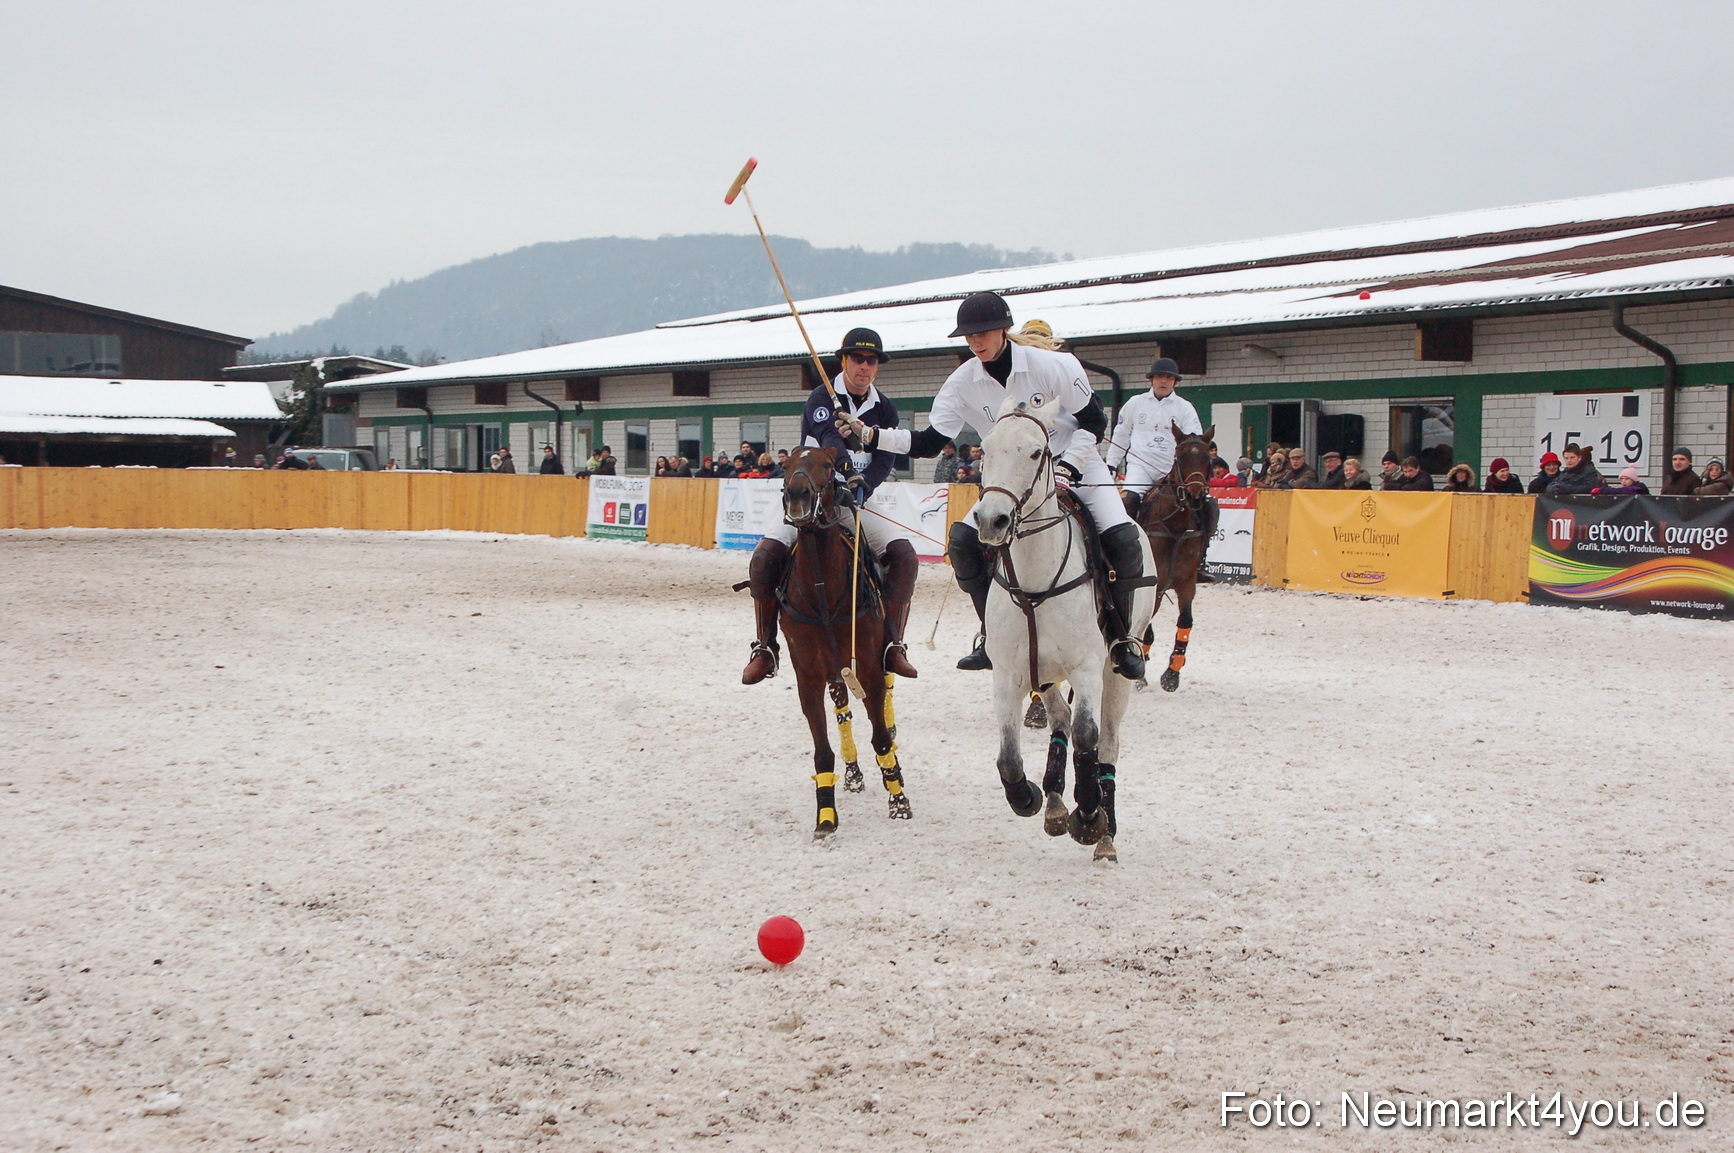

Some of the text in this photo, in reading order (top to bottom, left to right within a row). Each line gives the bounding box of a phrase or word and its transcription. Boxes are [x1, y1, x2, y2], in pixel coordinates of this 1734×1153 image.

[1074, 377, 1090, 397] 1
[1586, 399, 1598, 416] IV
[1139, 413, 1147, 424] 2
[1599, 430, 1643, 464] 19
[1211, 529, 1226, 542] RS
[1333, 526, 1400, 548] Veuve Clicquot
[1577, 520, 1728, 551] network lounge
[1577, 542, 1690, 555] Grafik, Design, Produktion, Events
[1650, 600, 1725, 611] www.network-lounge.de
